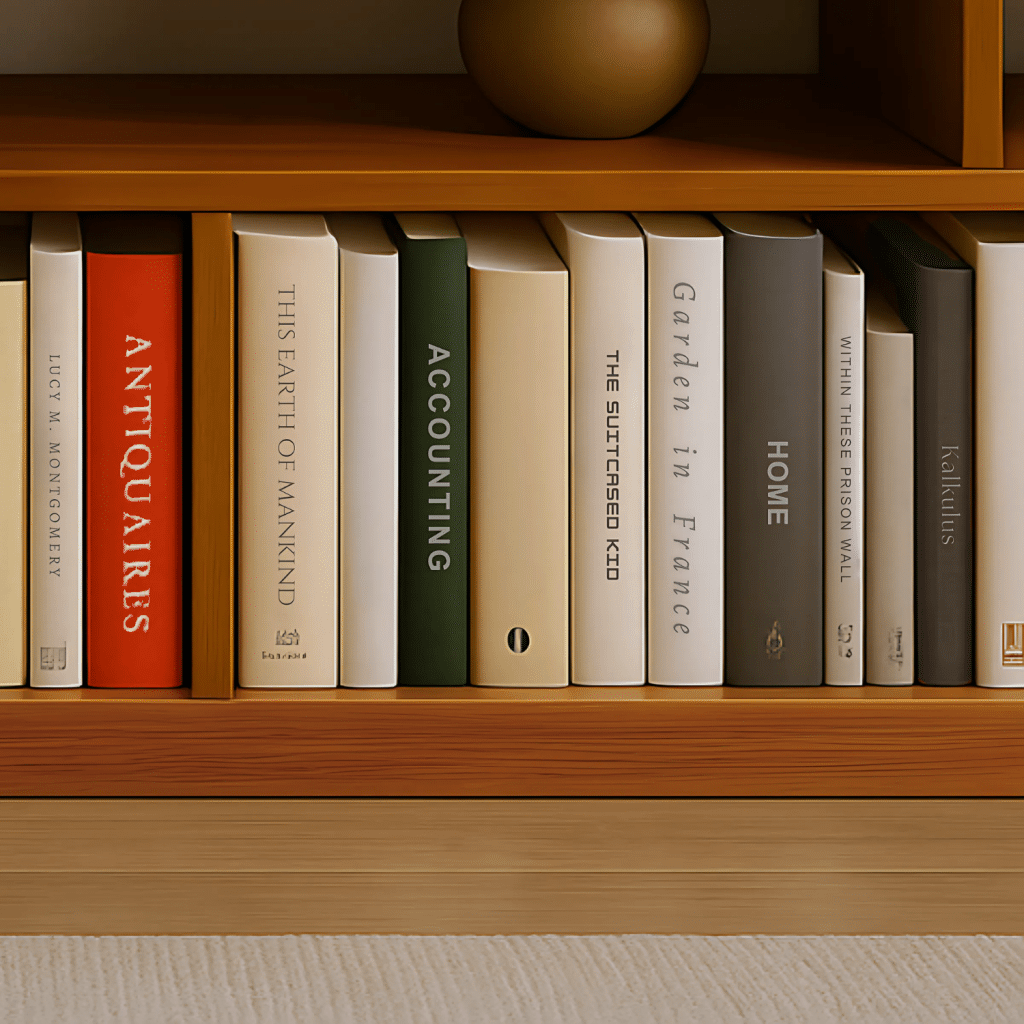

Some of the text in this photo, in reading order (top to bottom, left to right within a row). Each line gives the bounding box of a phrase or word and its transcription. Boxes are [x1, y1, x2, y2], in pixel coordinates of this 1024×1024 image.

[48, 354, 62, 579] LUCY M. MONTGOMERY
[119, 335, 153, 634] ANTIQUAIRES
[277, 284, 296, 606] THIS EARTH OF MANKIND
[427, 343, 451, 571] ACCOUNTING
[606, 350, 620, 581] THE SUITCASED KID
[673, 281, 699, 636] Garden in France
[767, 441, 789, 525] HOME
[840, 335, 852, 583] WITHIN THESE PRISON WALL
[941, 445, 960, 546] Kalkulus
